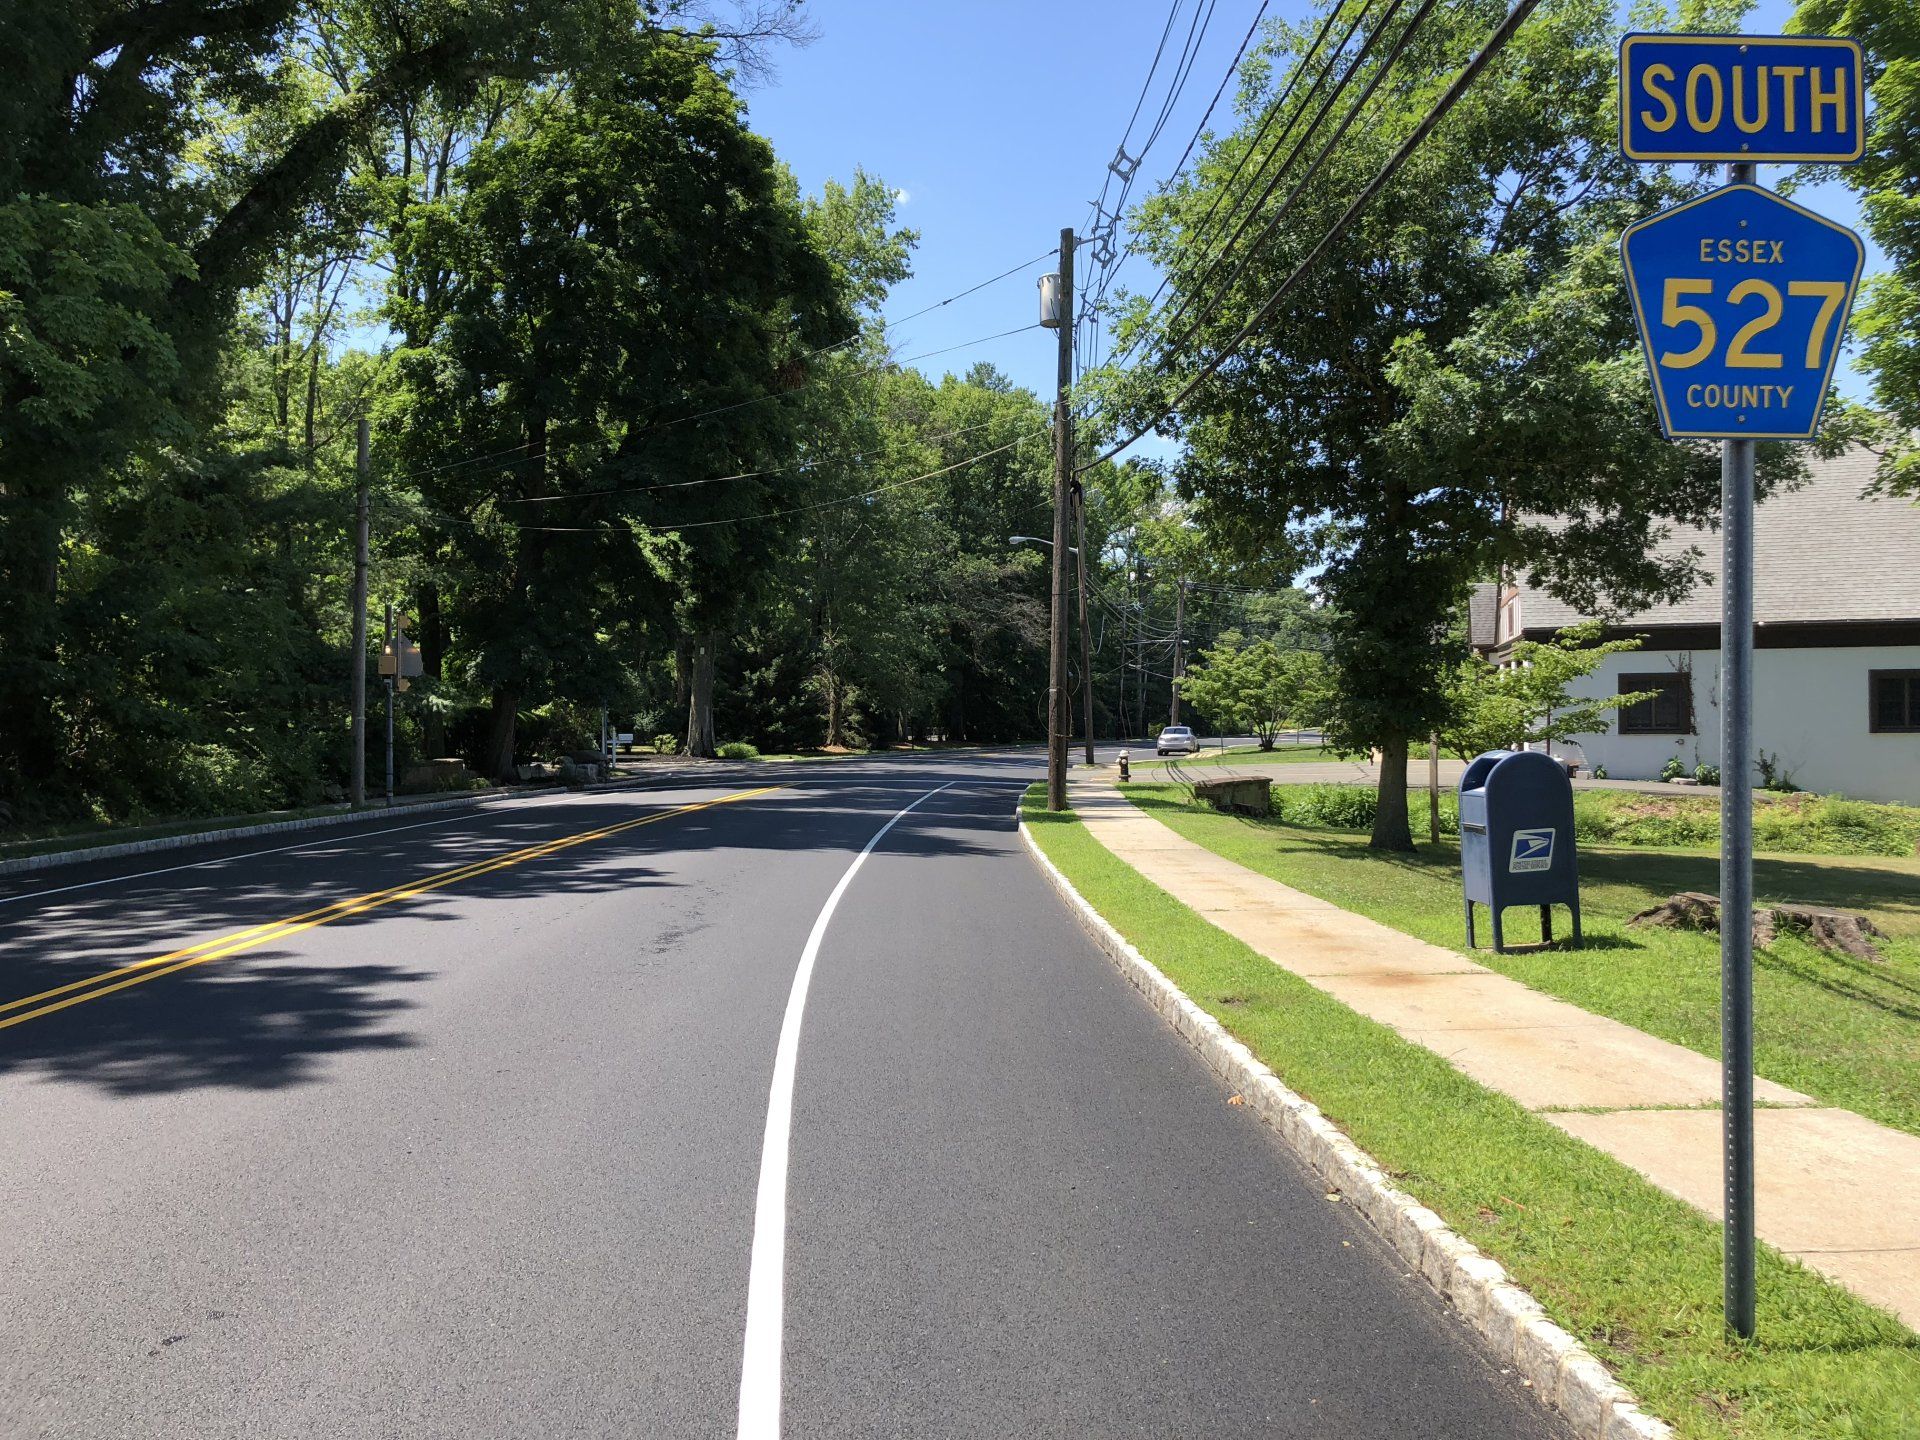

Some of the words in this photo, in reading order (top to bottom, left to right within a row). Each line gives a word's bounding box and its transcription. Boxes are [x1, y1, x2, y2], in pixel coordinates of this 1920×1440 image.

[1641, 63, 1847, 134] SOUTH
[1699, 239, 1785, 265] ESSEX
[1660, 277, 1847, 369] 527
[1686, 384, 1794, 409] COUNTY
